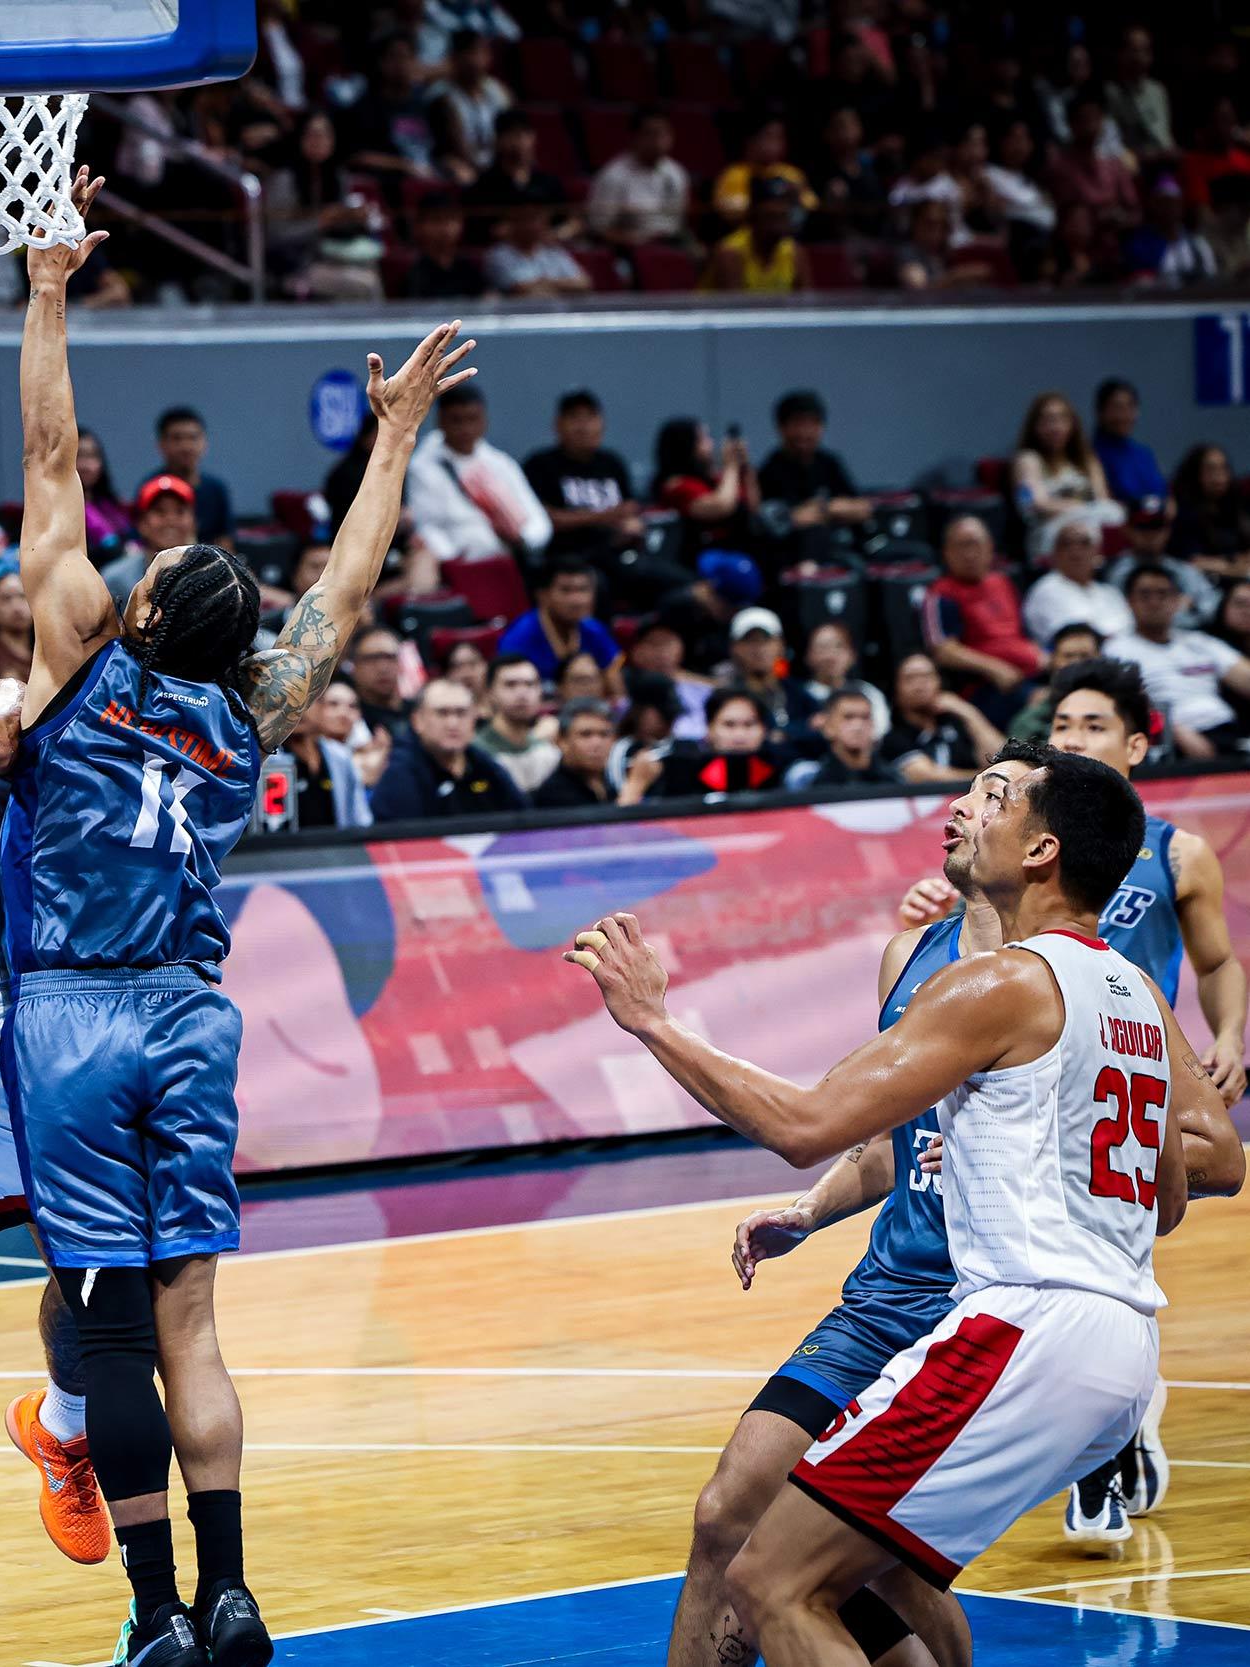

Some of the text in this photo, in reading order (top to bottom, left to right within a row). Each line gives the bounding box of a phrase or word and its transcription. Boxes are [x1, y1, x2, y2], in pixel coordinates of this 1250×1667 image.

[157, 691, 205, 707] SPECTRUM
[129, 750, 207, 856] 11
[262, 772, 288, 816] 2
[1098, 1011, 1163, 1063] J. AGUILAR
[1089, 1065, 1167, 1211] 25
